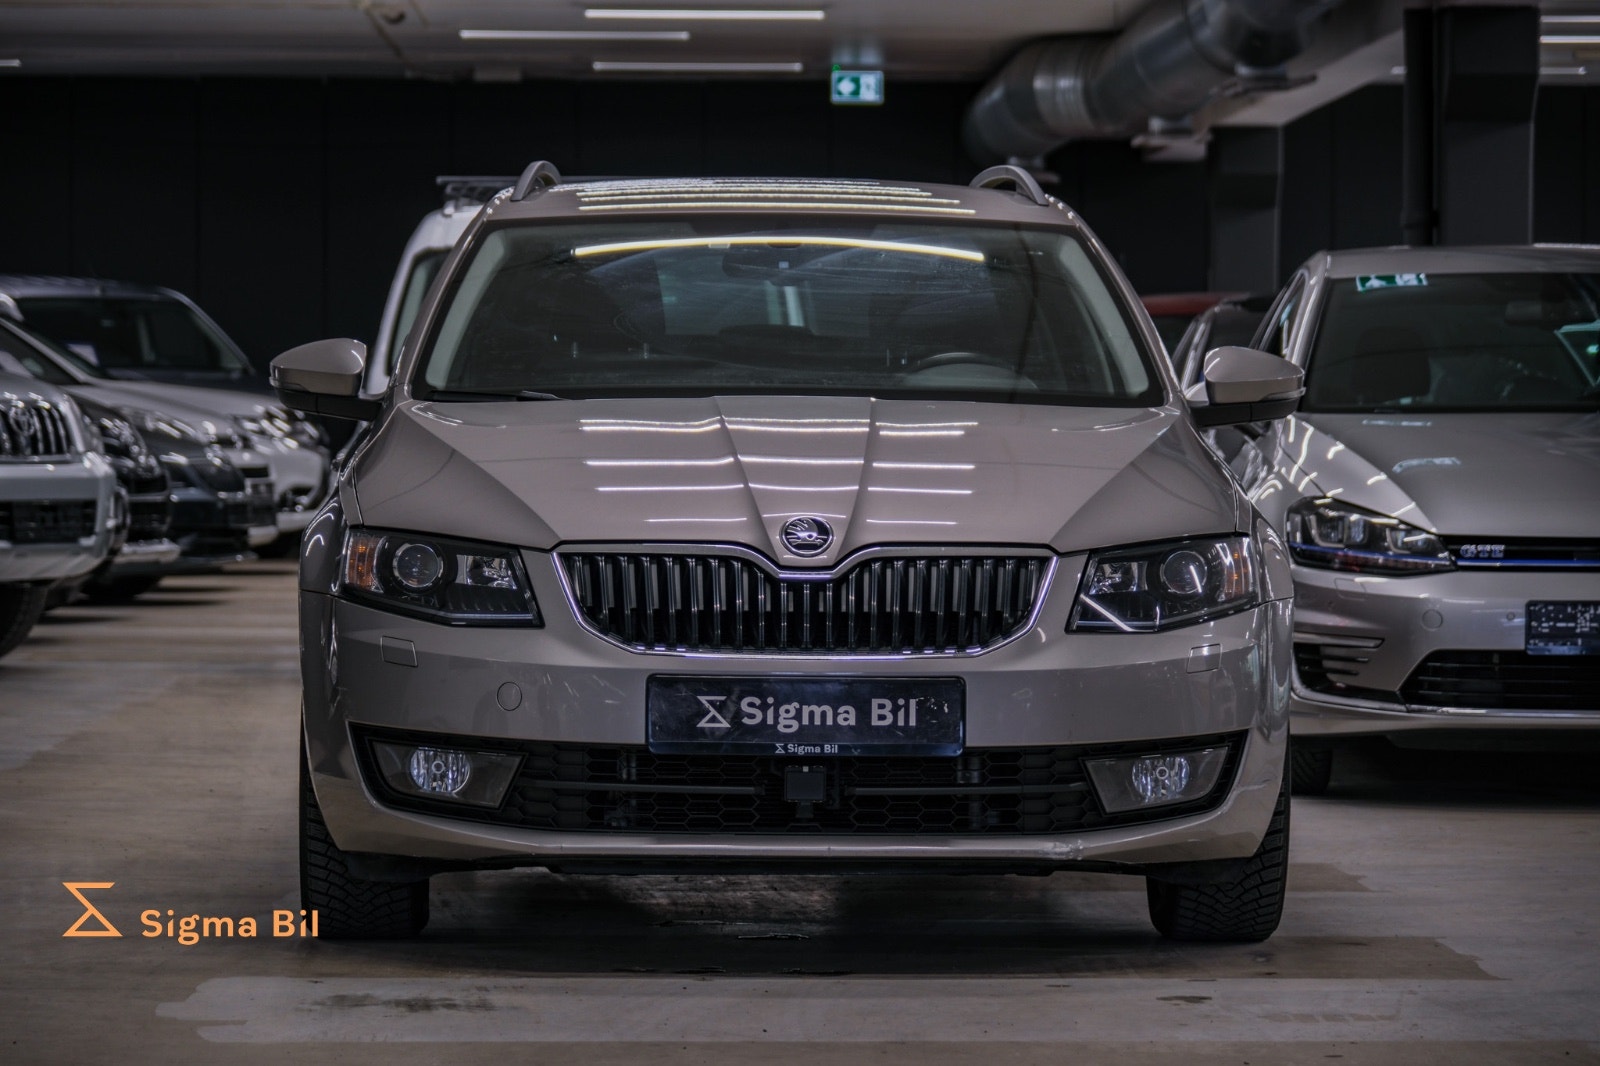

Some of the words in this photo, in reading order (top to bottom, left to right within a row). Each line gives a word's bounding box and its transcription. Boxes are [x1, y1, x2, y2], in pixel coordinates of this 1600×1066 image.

[1460, 544, 1505, 558] GTE
[740, 697, 857, 733] Sigma
[871, 698, 917, 727] Bil
[787, 743, 821, 755] Sigma
[823, 744, 838, 754] Bil
